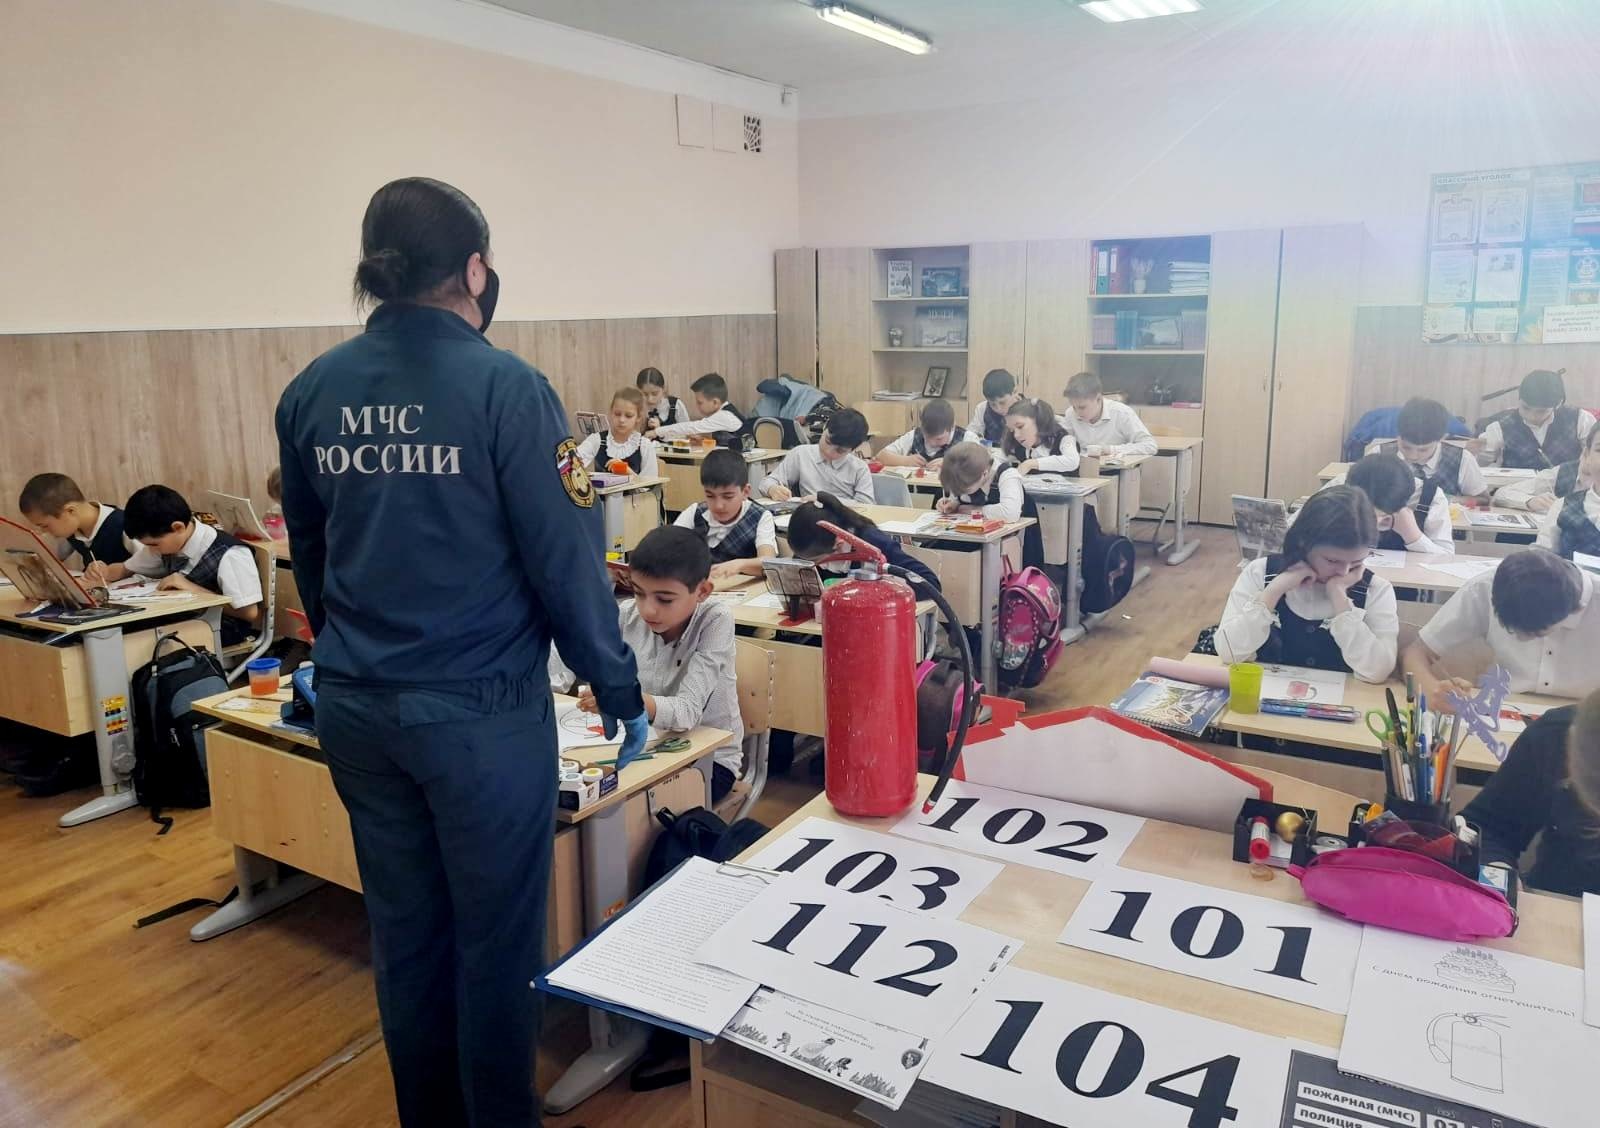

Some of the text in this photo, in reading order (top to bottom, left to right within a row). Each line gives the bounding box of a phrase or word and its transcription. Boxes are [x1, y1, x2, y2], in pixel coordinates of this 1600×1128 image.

[341, 404, 424, 435] МЧС
[314, 443, 463, 474] РОССИИ
[920, 797, 1109, 863] 102
[774, 837, 961, 911] 103
[752, 902, 959, 997] 112
[1090, 890, 1318, 985] 101
[960, 999, 1240, 1128] 104
[1303, 1086, 1375, 1111] ПОЖАРНАЯ
[1377, 1105, 1416, 1123] (МЧС)
